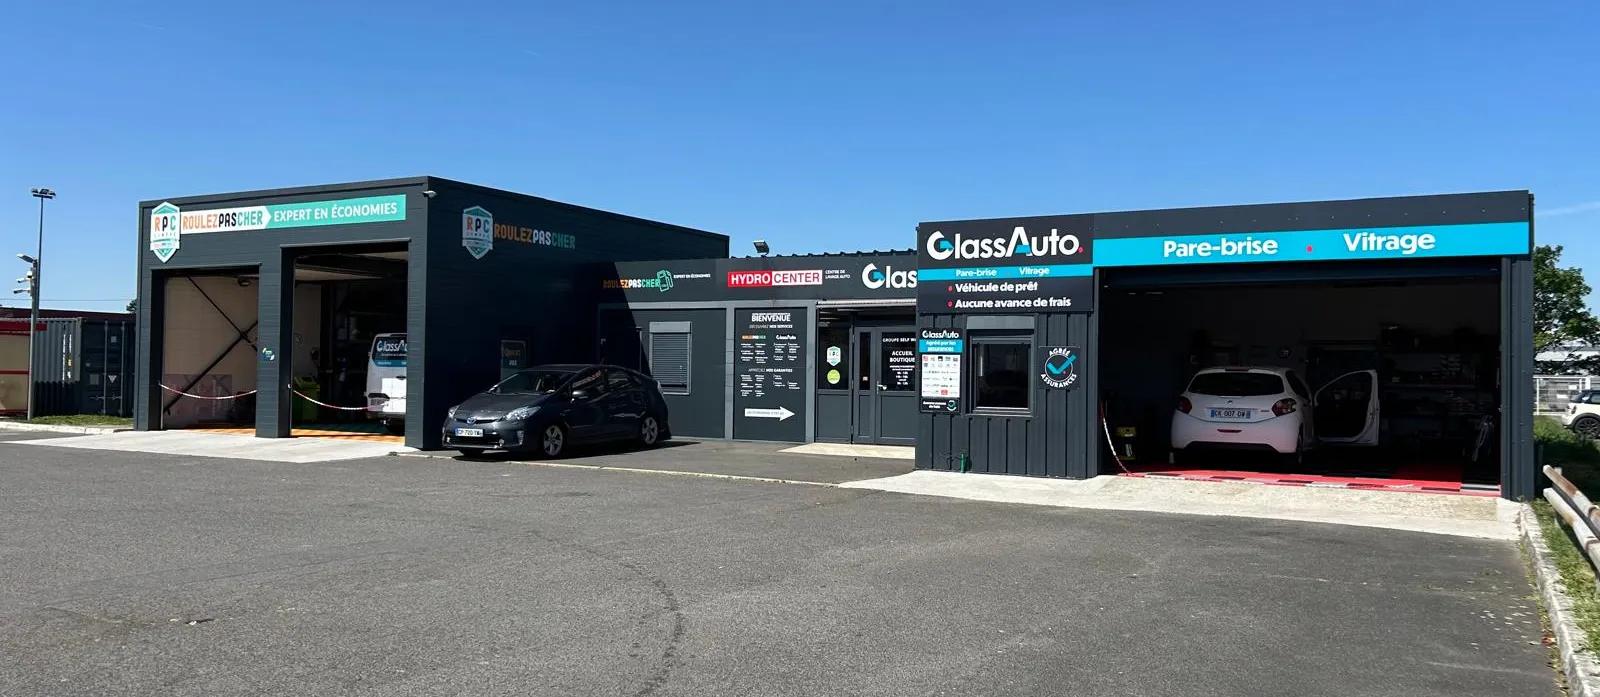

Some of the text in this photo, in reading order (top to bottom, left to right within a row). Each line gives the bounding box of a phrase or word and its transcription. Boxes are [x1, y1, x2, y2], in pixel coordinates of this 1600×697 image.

[274, 202, 398, 223] EXPERT EN ÉCONOMIES
[183, 210, 263, 230] ROULEZPASCHER
[1163, 231, 1435, 259] Pare-brise Vitrage
[731, 271, 820, 285] HYDRO CENTER
[956, 266, 1050, 277] Pare-brise Vitrage
[955, 281, 1038, 294] Véhicule de prêt
[955, 297, 1072, 309] Aucune avance de frais
[752, 313, 791, 322] BIENVENUE
[1040, 373, 1077, 388] ASSURANCES
